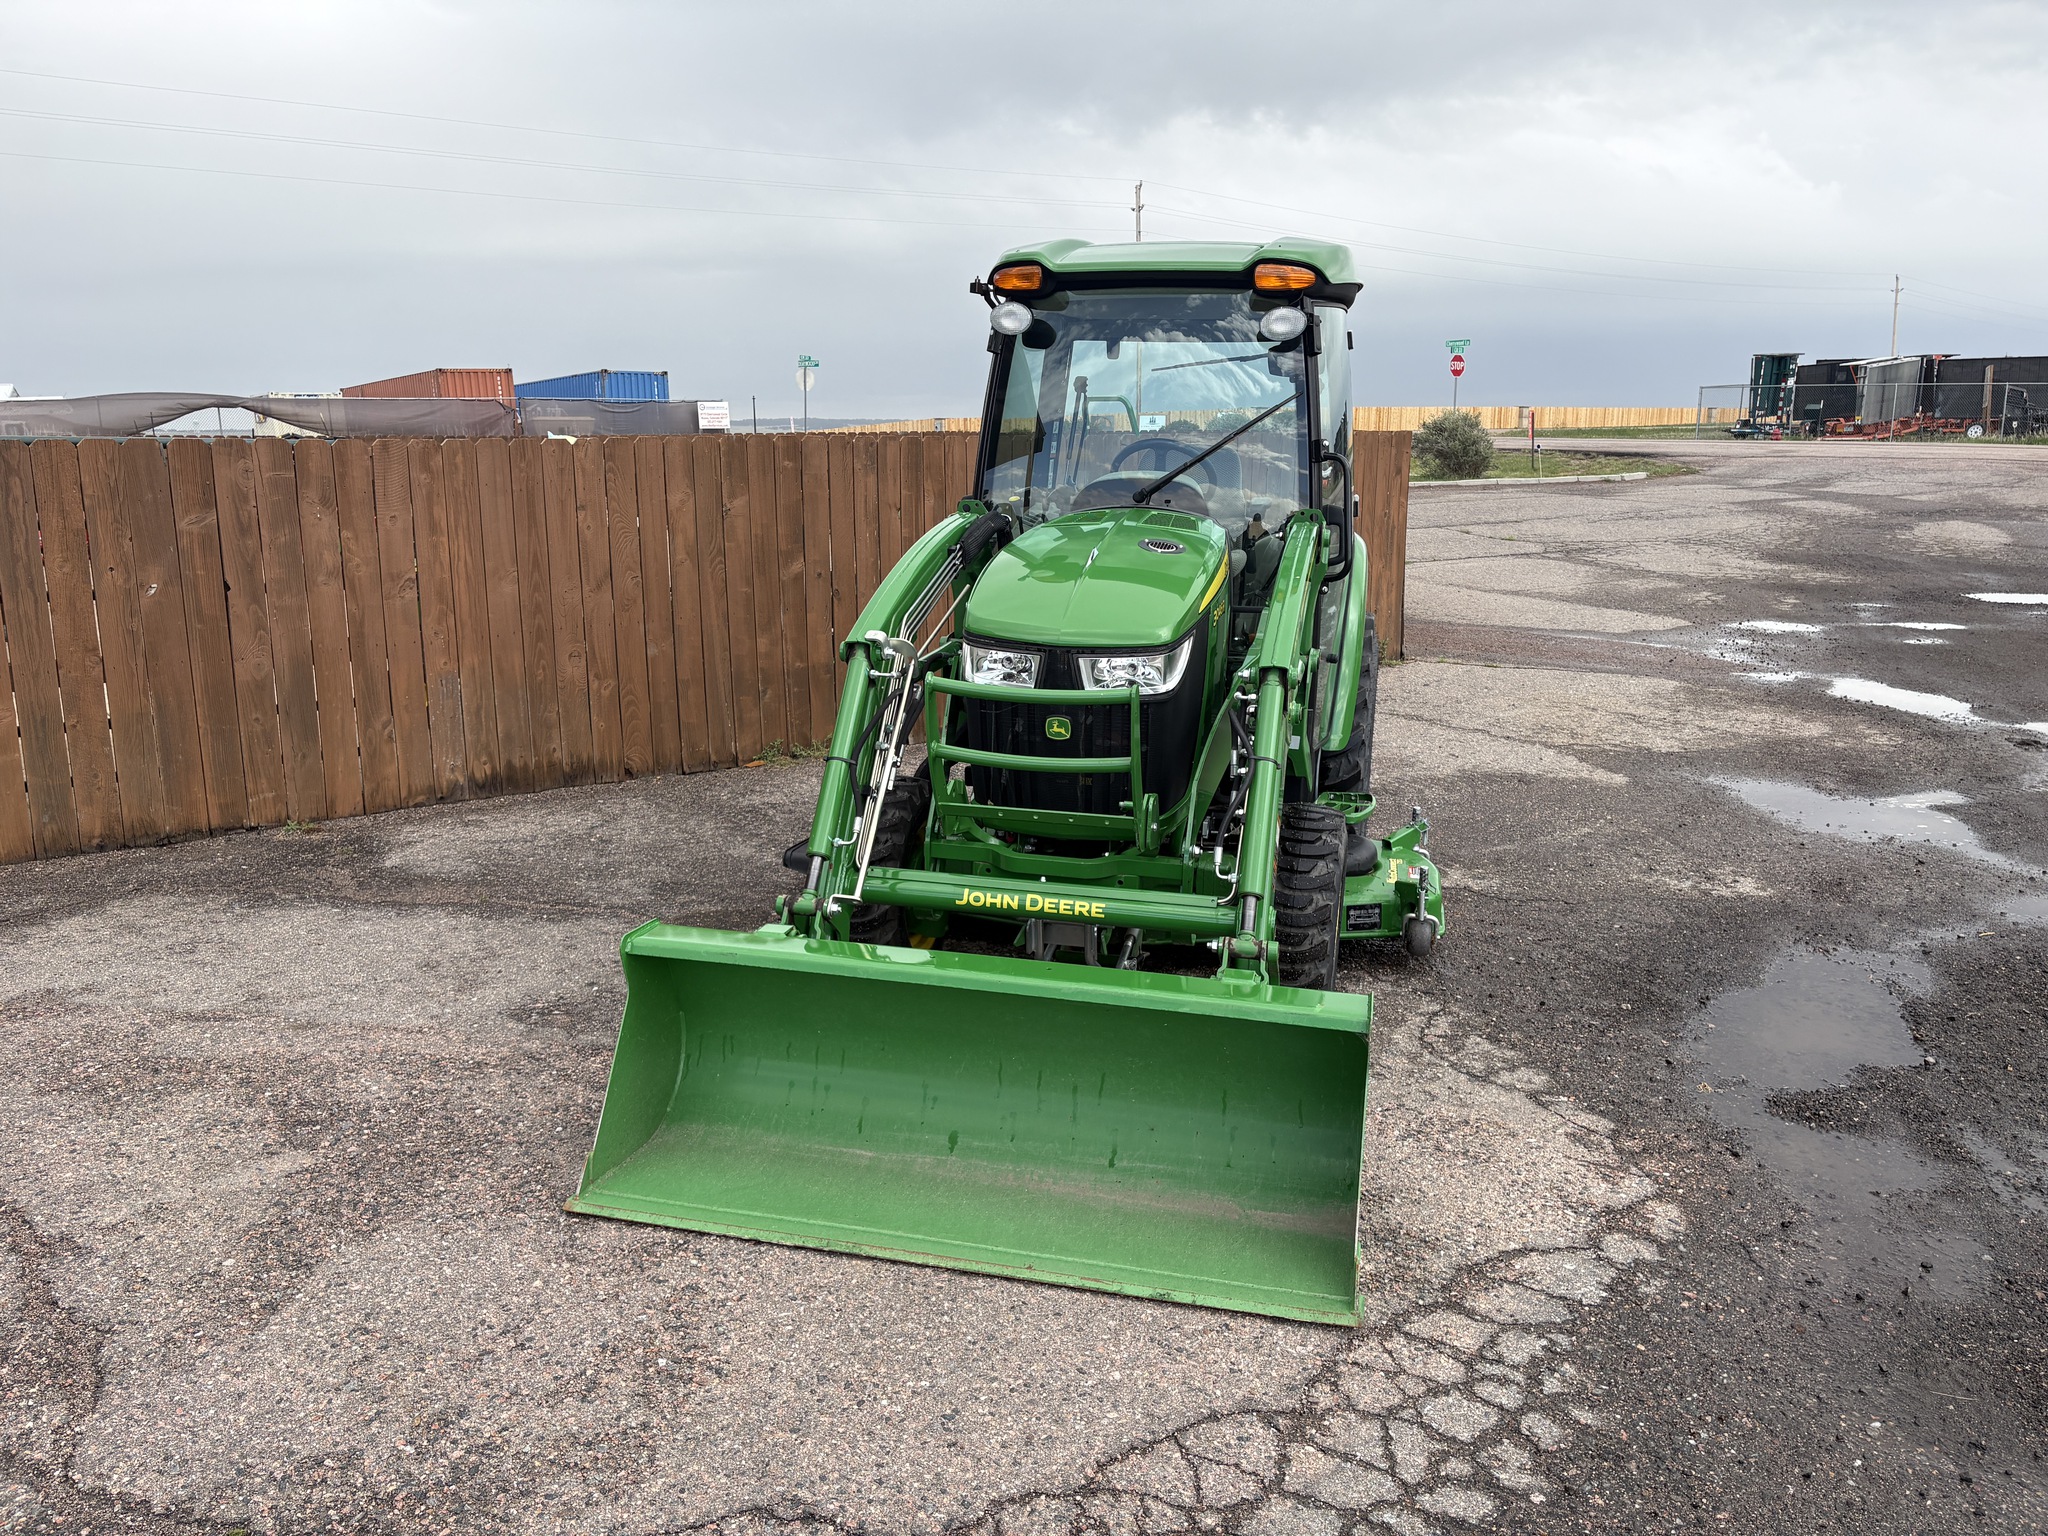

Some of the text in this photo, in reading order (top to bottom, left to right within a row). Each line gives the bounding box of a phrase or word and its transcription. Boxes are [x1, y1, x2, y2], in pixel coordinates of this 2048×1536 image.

[1451, 361, 1464, 370] STOP
[955, 888, 1106, 919] JOHN DEERE
